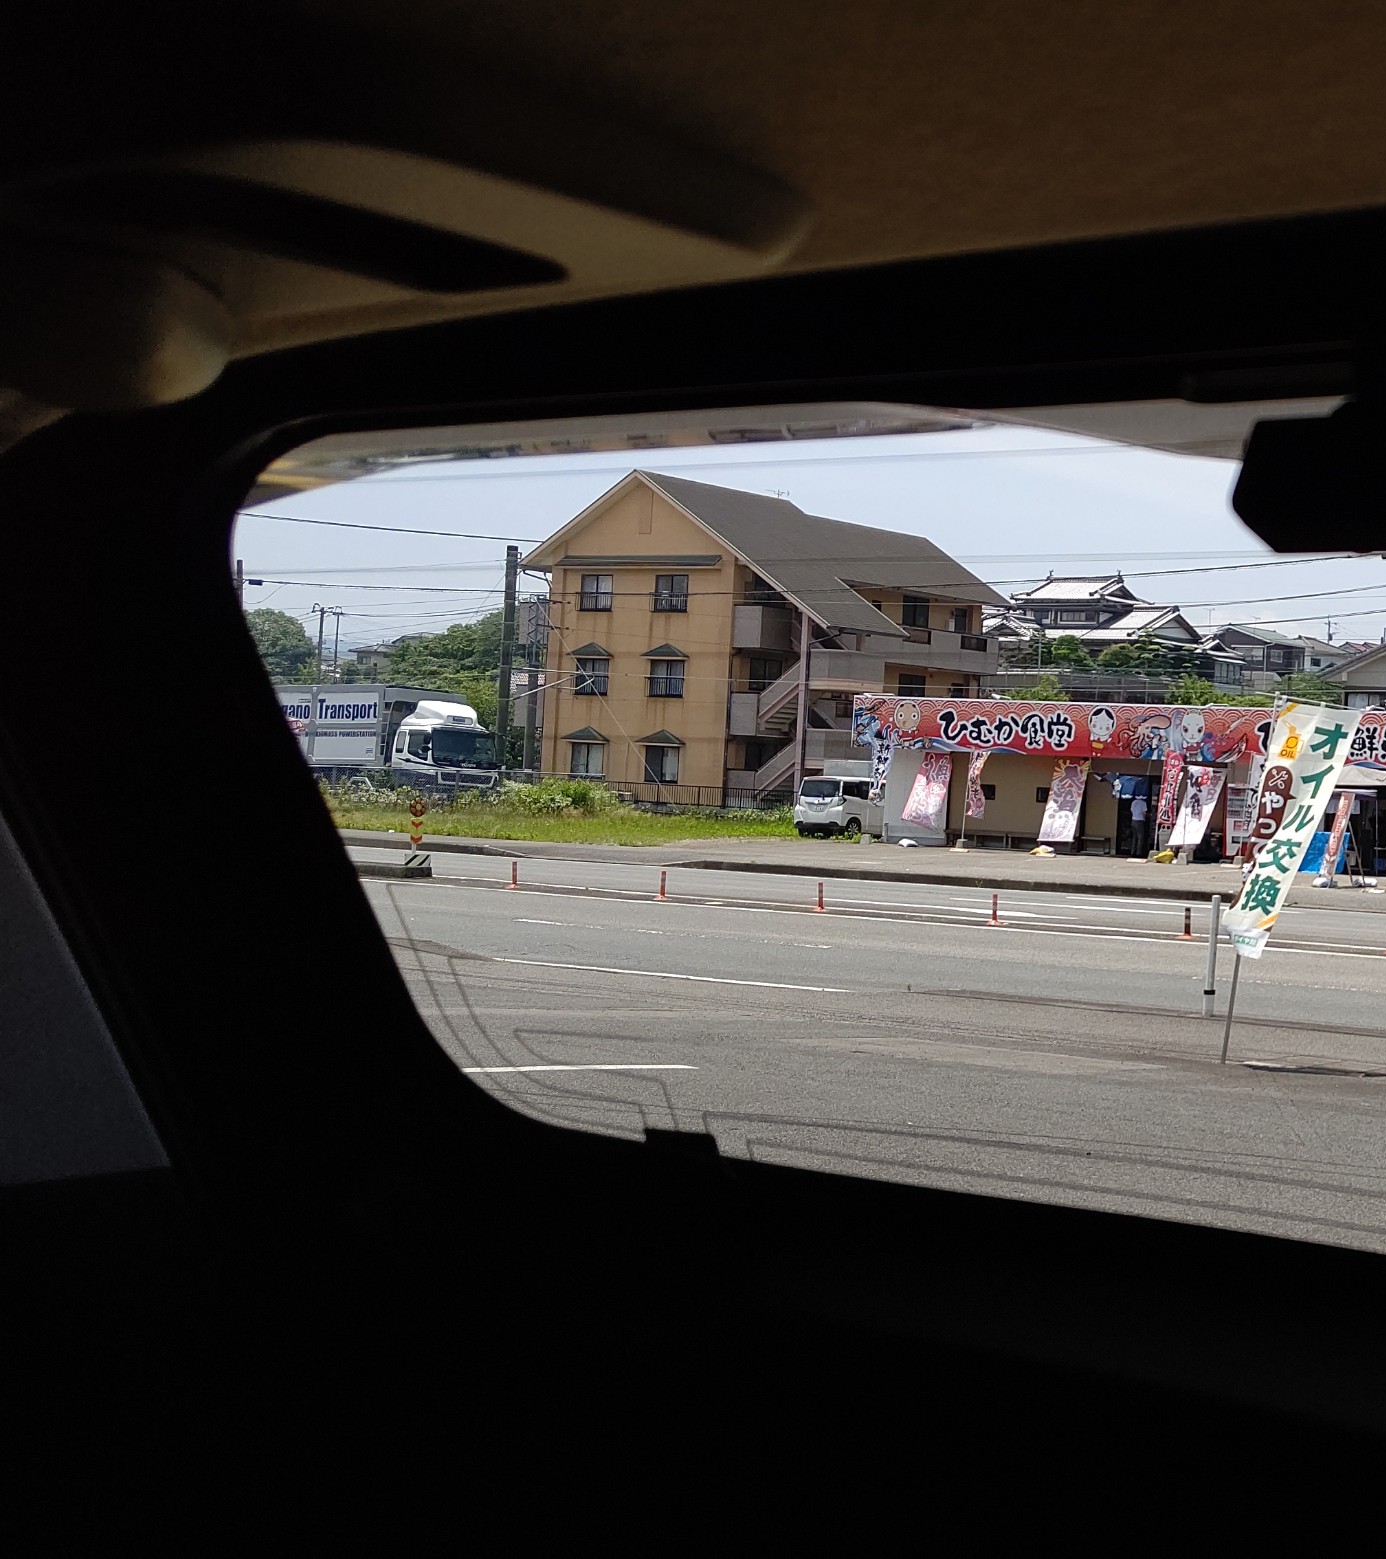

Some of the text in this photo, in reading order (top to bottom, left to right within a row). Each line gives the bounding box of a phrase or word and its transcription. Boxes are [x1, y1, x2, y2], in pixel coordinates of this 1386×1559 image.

[318, 698, 378, 721] Transport
[939, 710, 1074, 748] ひむか食堂
[1280, 749, 1296, 760] OIL
[1240, 723, 1349, 916] オイル交換
[1241, 791, 1284, 881] やって
